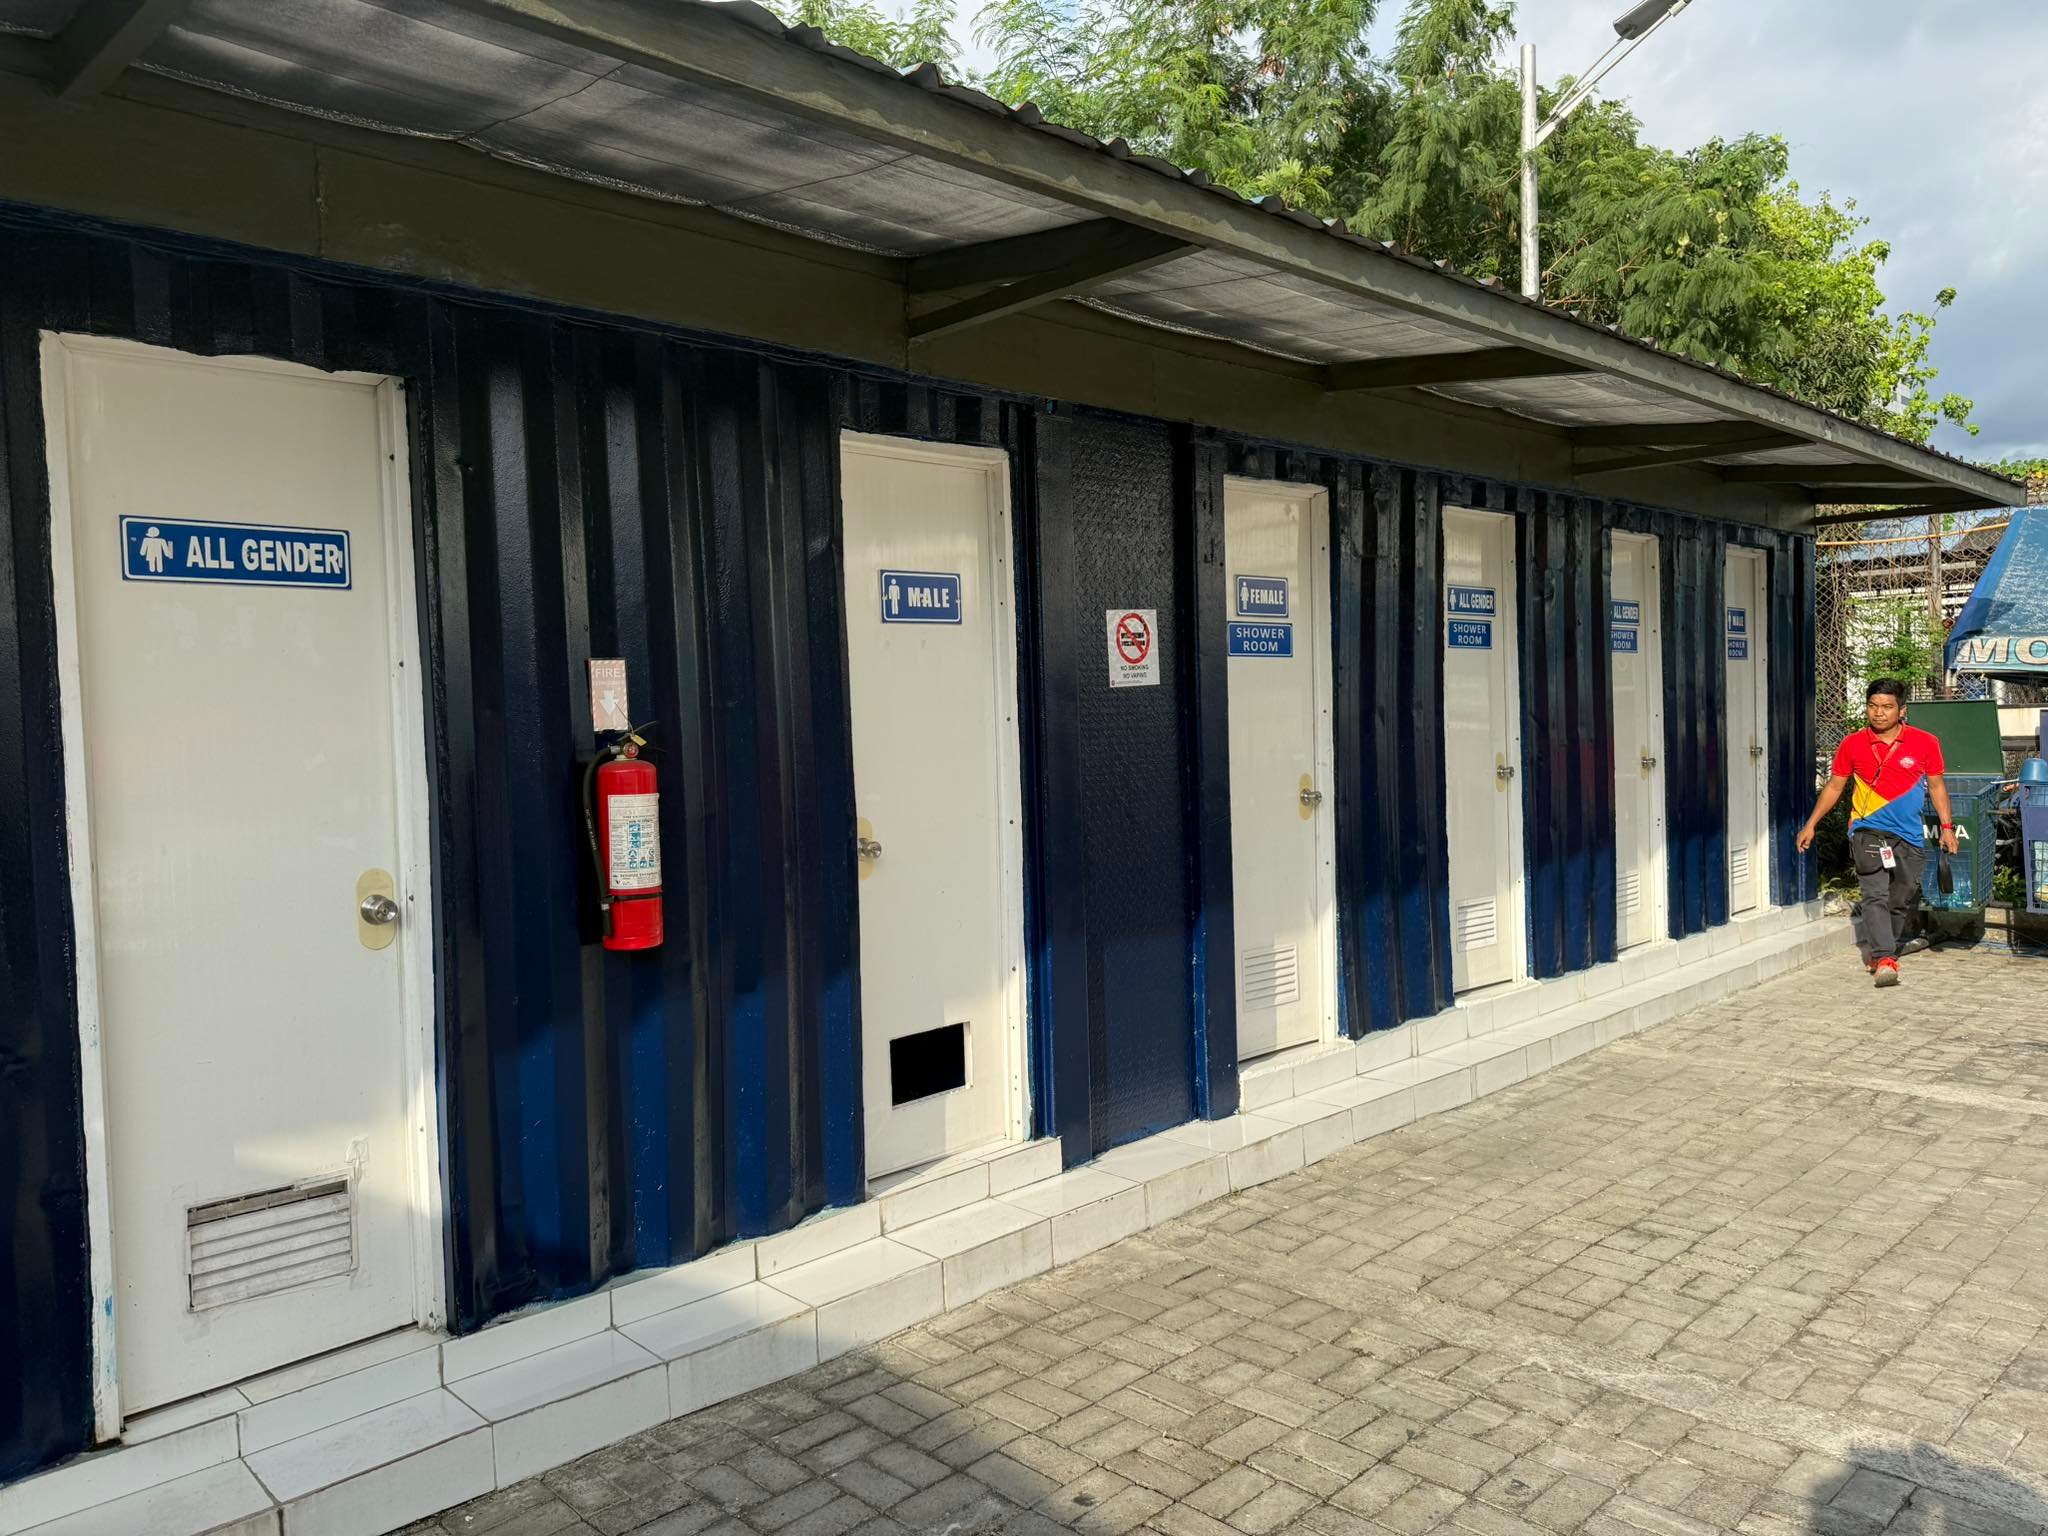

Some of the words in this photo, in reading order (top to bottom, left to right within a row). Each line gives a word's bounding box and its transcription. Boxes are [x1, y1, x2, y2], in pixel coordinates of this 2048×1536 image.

[186, 535, 235, 570] ALL
[241, 538, 342, 574] GENDER
[907, 586, 950, 608] MALE
[1250, 588, 1284, 605] FEMALE
[1459, 592, 1470, 608] ALL
[1471, 593, 1494, 609] GENDER
[1613, 605, 1622, 619] ALL
[1236, 627, 1285, 639] SHOWER
[1453, 623, 1487, 634] SHOWER
[1243, 640, 1278, 652] ROOM
[1457, 635, 1482, 645] ROOM
[1613, 640, 1631, 649] ROOM
[595, 667, 621, 678] FIRE
